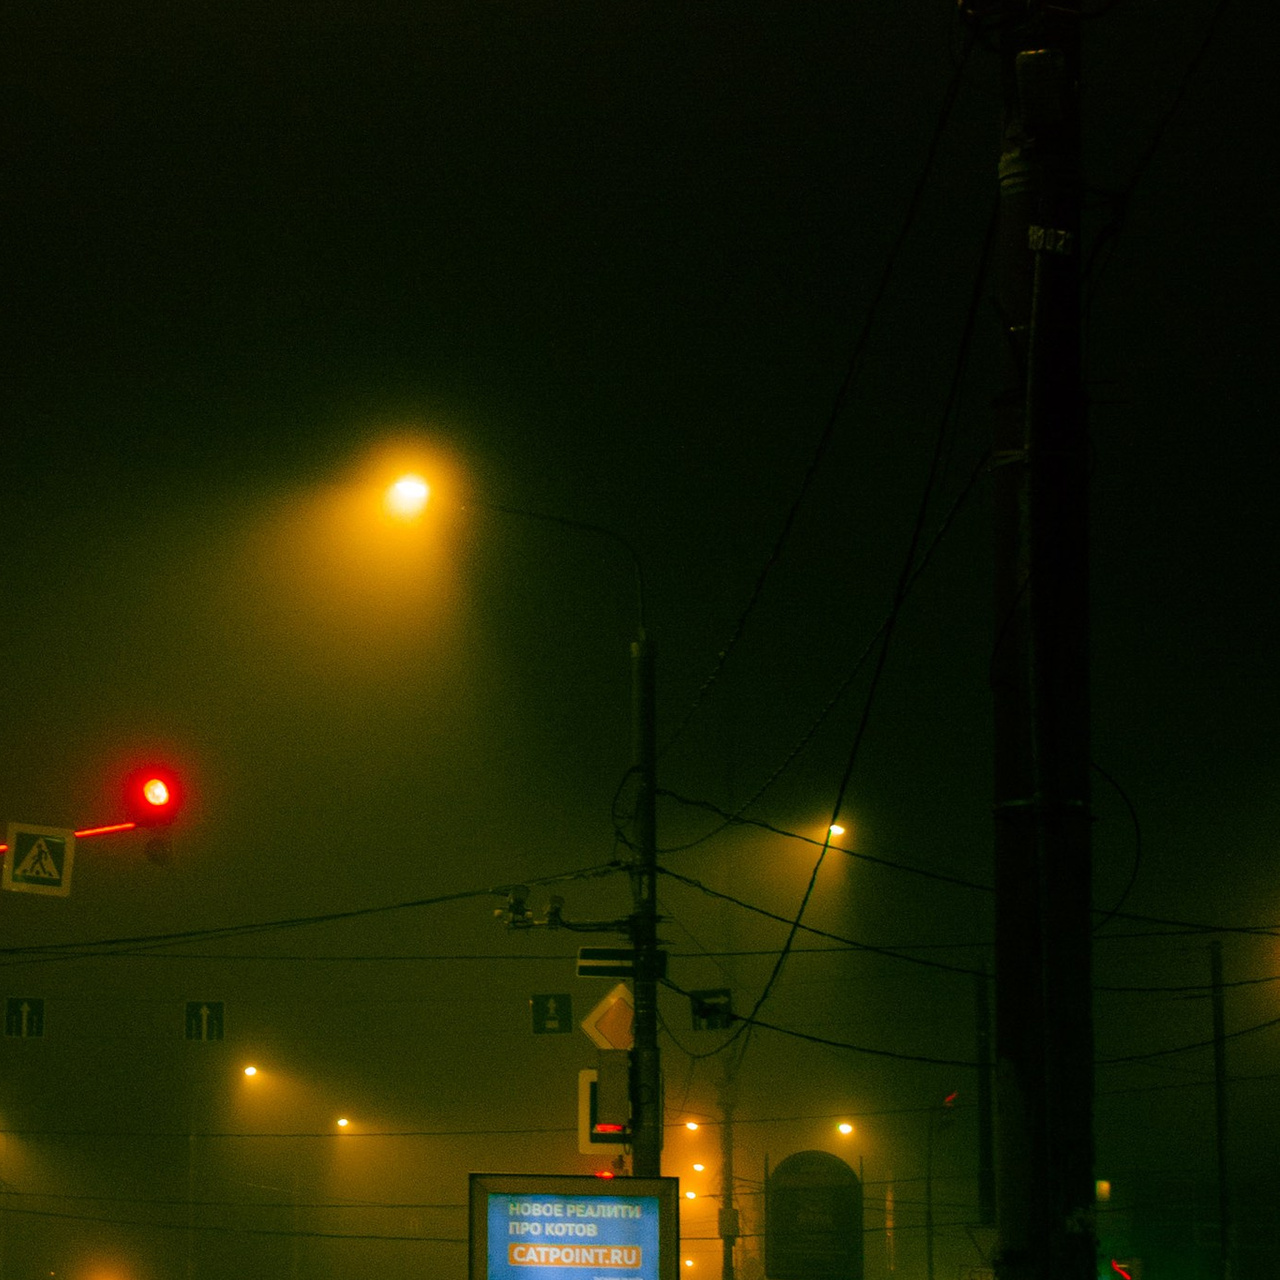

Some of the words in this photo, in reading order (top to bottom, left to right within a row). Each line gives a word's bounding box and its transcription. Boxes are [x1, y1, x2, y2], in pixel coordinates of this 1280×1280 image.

[509, 1202, 564, 1217] НОВОЕ
[566, 1204, 641, 1218] РЕАЛИТИ
[509, 1222, 542, 1235] ПРО
[545, 1223, 598, 1237] КОТОВ
[512, 1247, 637, 1265] CATPOINT.RU
